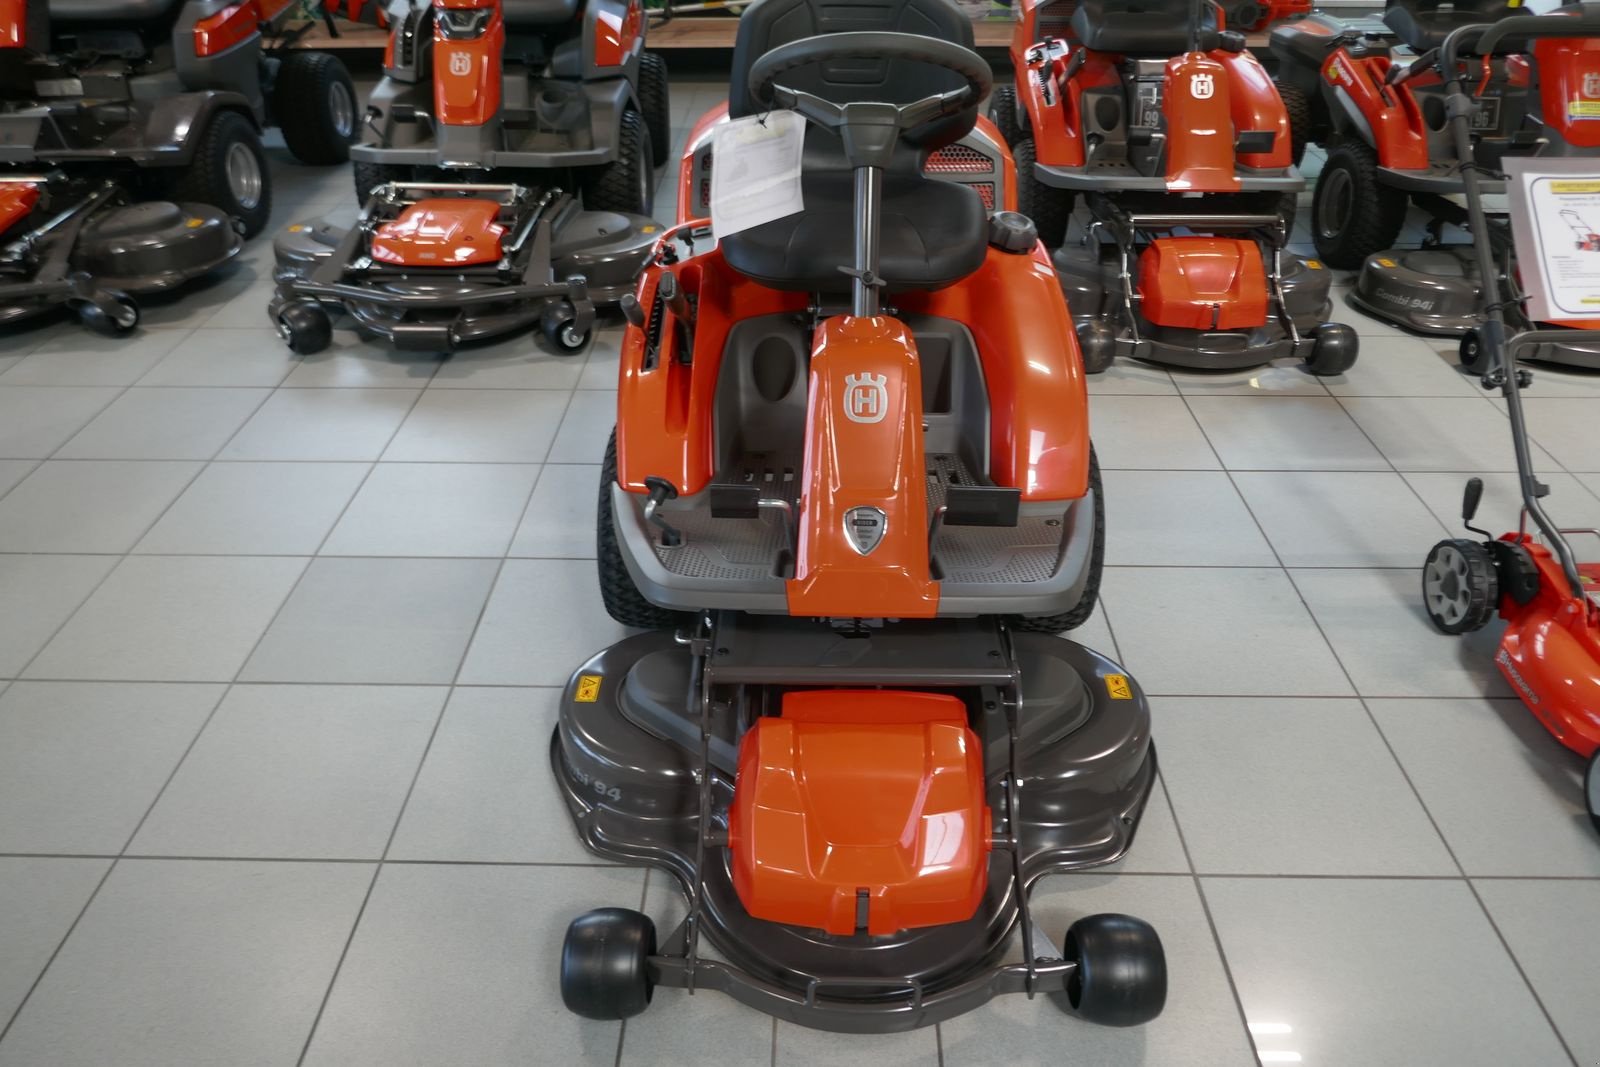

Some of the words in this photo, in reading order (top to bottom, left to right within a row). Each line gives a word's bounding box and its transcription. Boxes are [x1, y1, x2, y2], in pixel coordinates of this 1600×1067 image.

[1144, 111, 1158, 127] 99
[1376, 287, 1410, 306] Combi
[1410, 298, 1435, 311] 94i
[594, 780, 621, 801] 94
